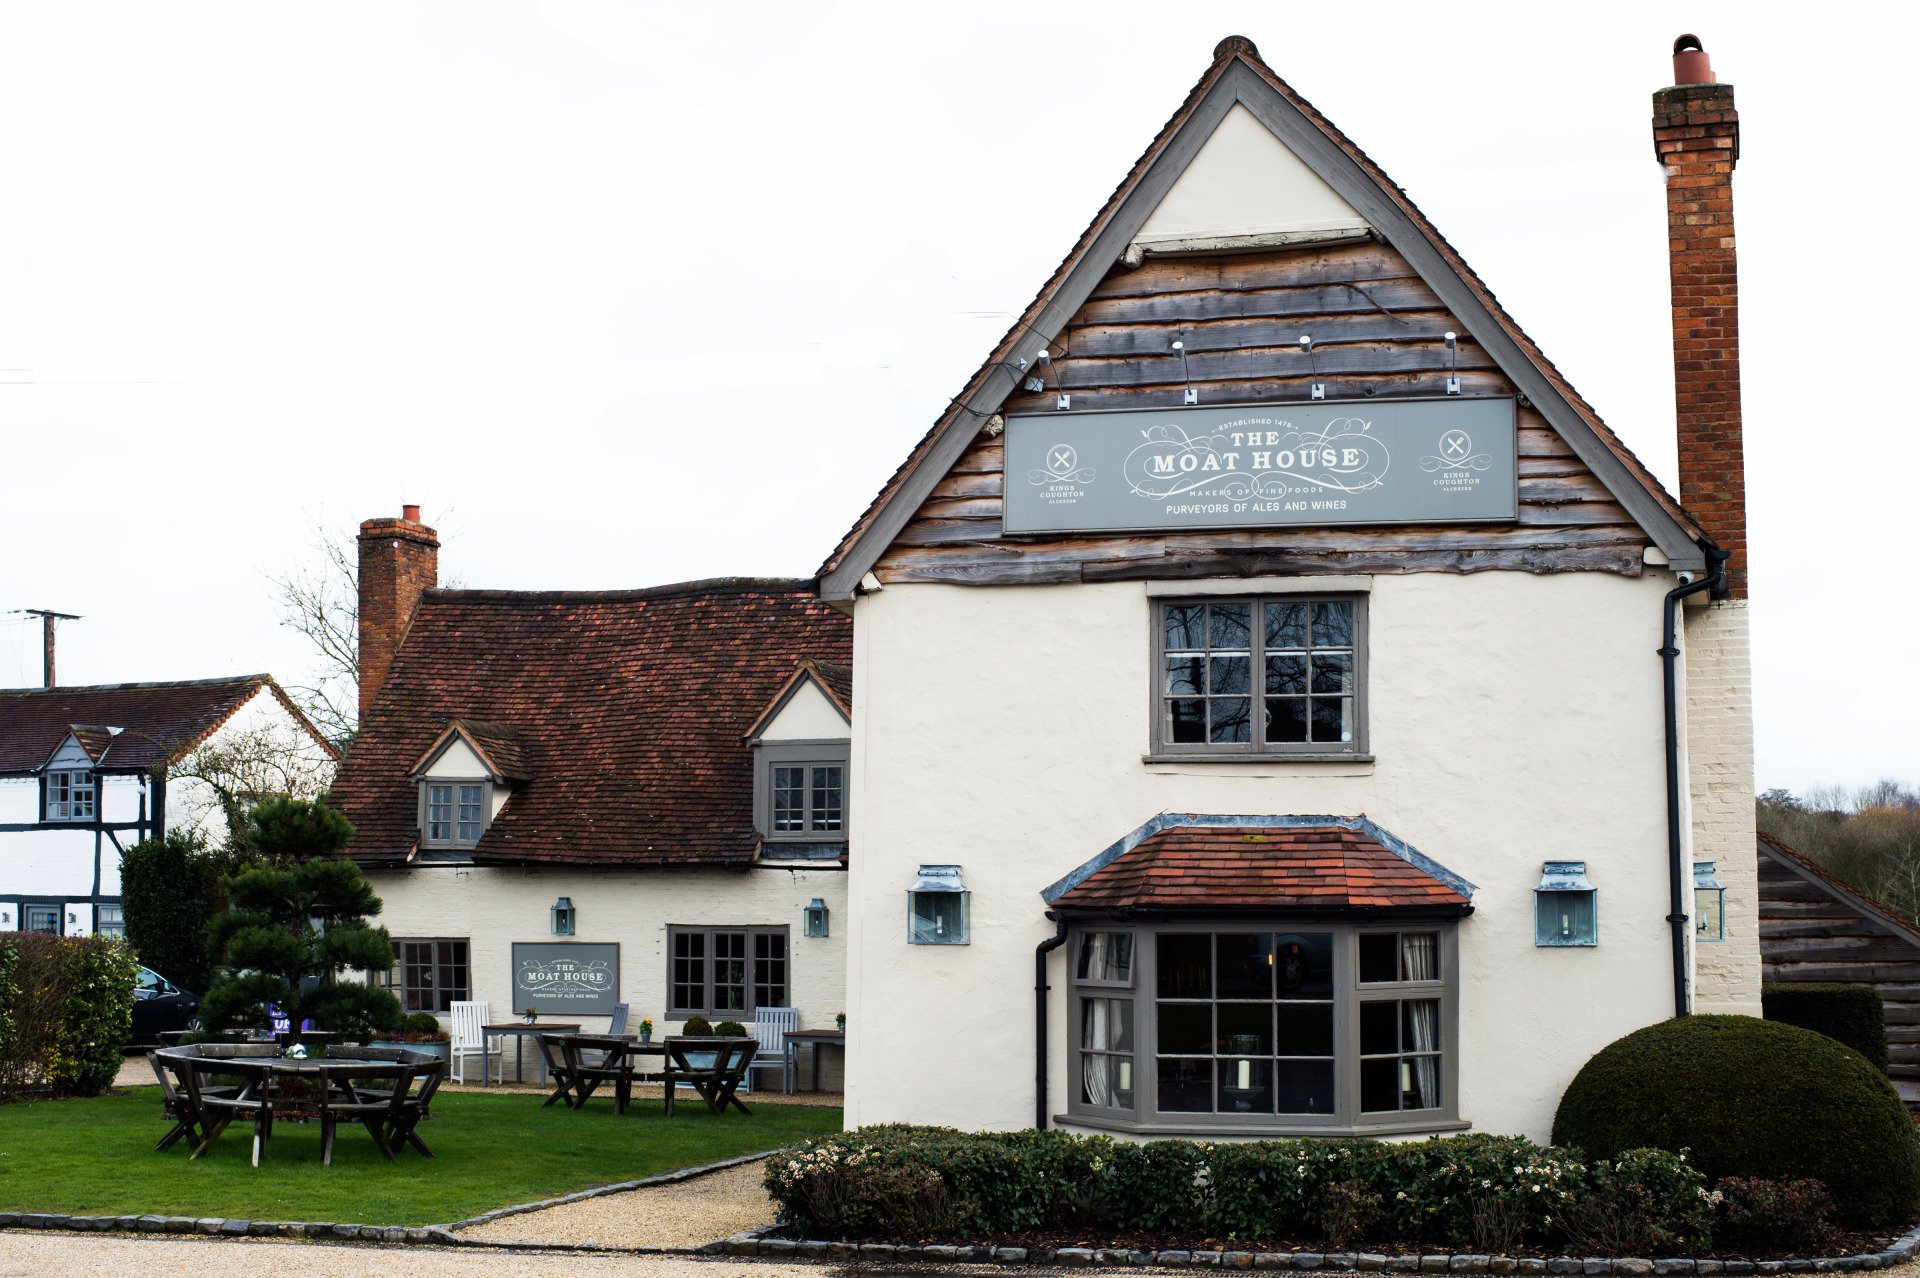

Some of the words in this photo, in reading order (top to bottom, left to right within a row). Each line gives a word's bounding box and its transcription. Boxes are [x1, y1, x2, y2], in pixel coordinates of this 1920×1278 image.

[1219, 419, 1272, 431] ESTABLISHED
[1274, 420, 1292, 429] 1478
[1231, 431, 1280, 447] THE
[1153, 453, 1240, 472] MOAT
[1252, 448, 1360, 469] HOUSE
[1433, 478, 1480, 486] COUGHTON
[1040, 491, 1084, 499] COUGHTON
[1189, 489, 1232, 497] MAKERS
[1237, 488, 1250, 496] OF
[1259, 487, 1283, 495] FINE
[1288, 486, 1323, 494] FOODS
[1166, 503, 1229, 515] PURVEYORS
[1233, 503, 1248, 513] OF
[1252, 502, 1280, 512] ALES
[1284, 501, 1308, 511] AND
[1311, 500, 1347, 510] WINES
[528, 972, 560, 981] MOAT
[564, 972, 603, 981] HOUSE
